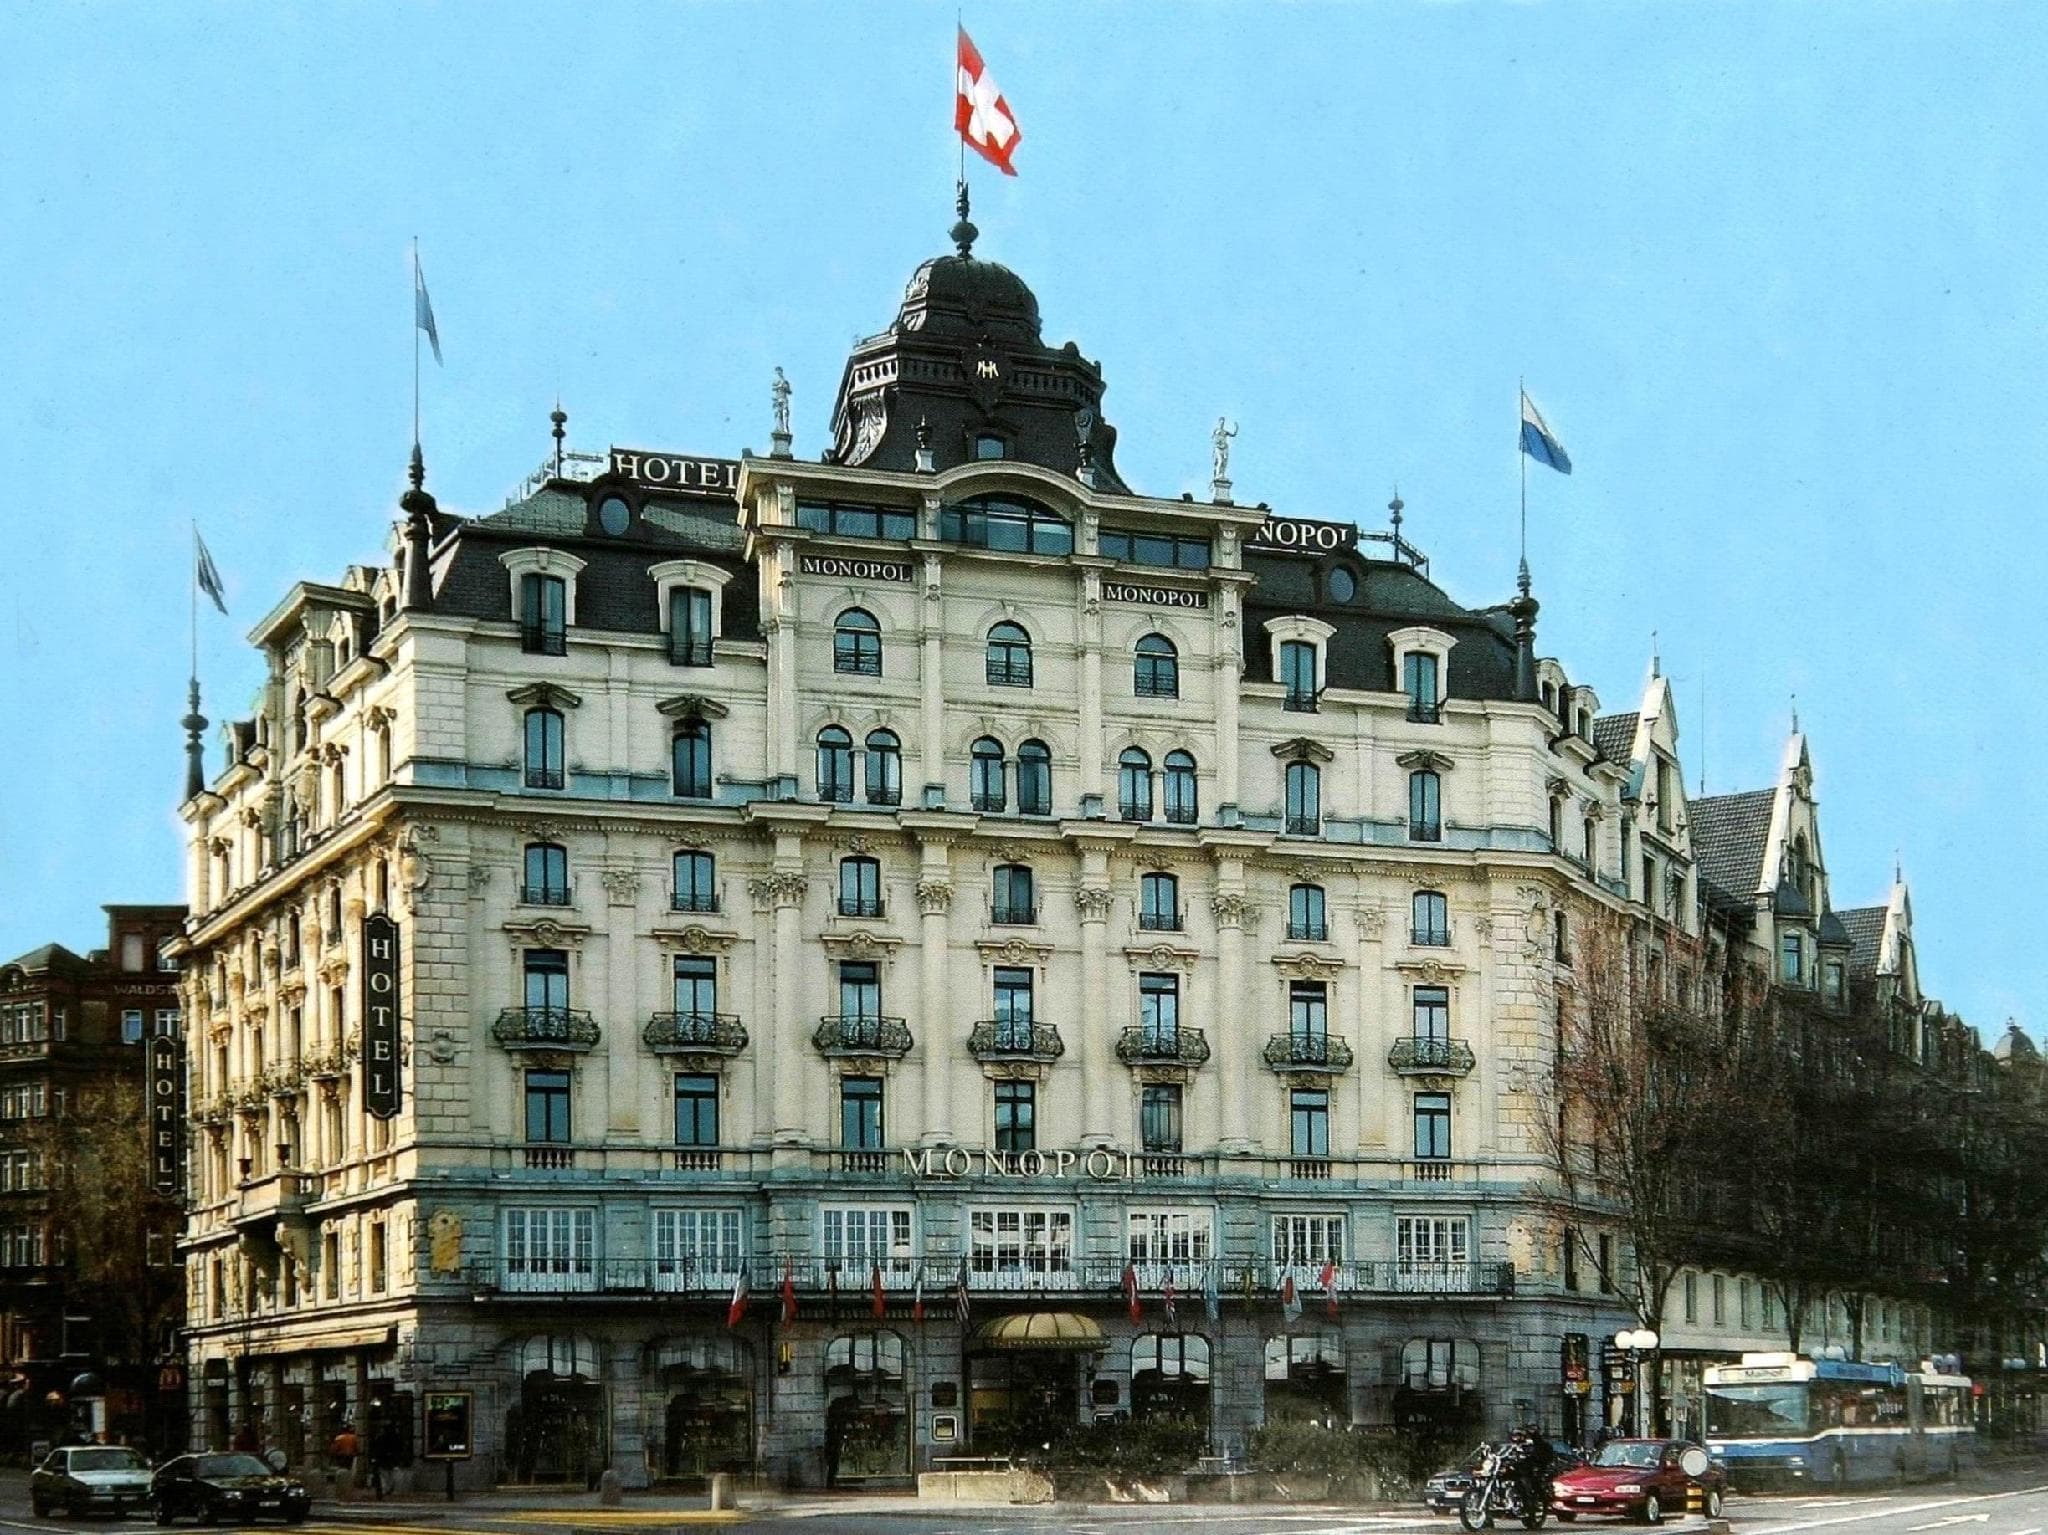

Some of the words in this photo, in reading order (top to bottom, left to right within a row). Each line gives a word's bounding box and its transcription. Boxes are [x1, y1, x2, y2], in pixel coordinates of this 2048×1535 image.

[803, 558, 911, 582] MONOPOL
[1106, 585, 1206, 608] MONOPOL
[371, 938, 392, 1095] HOTEL
[156, 1053, 173, 1173] HOTEL
[902, 1147, 1145, 1179] MONOPOL
